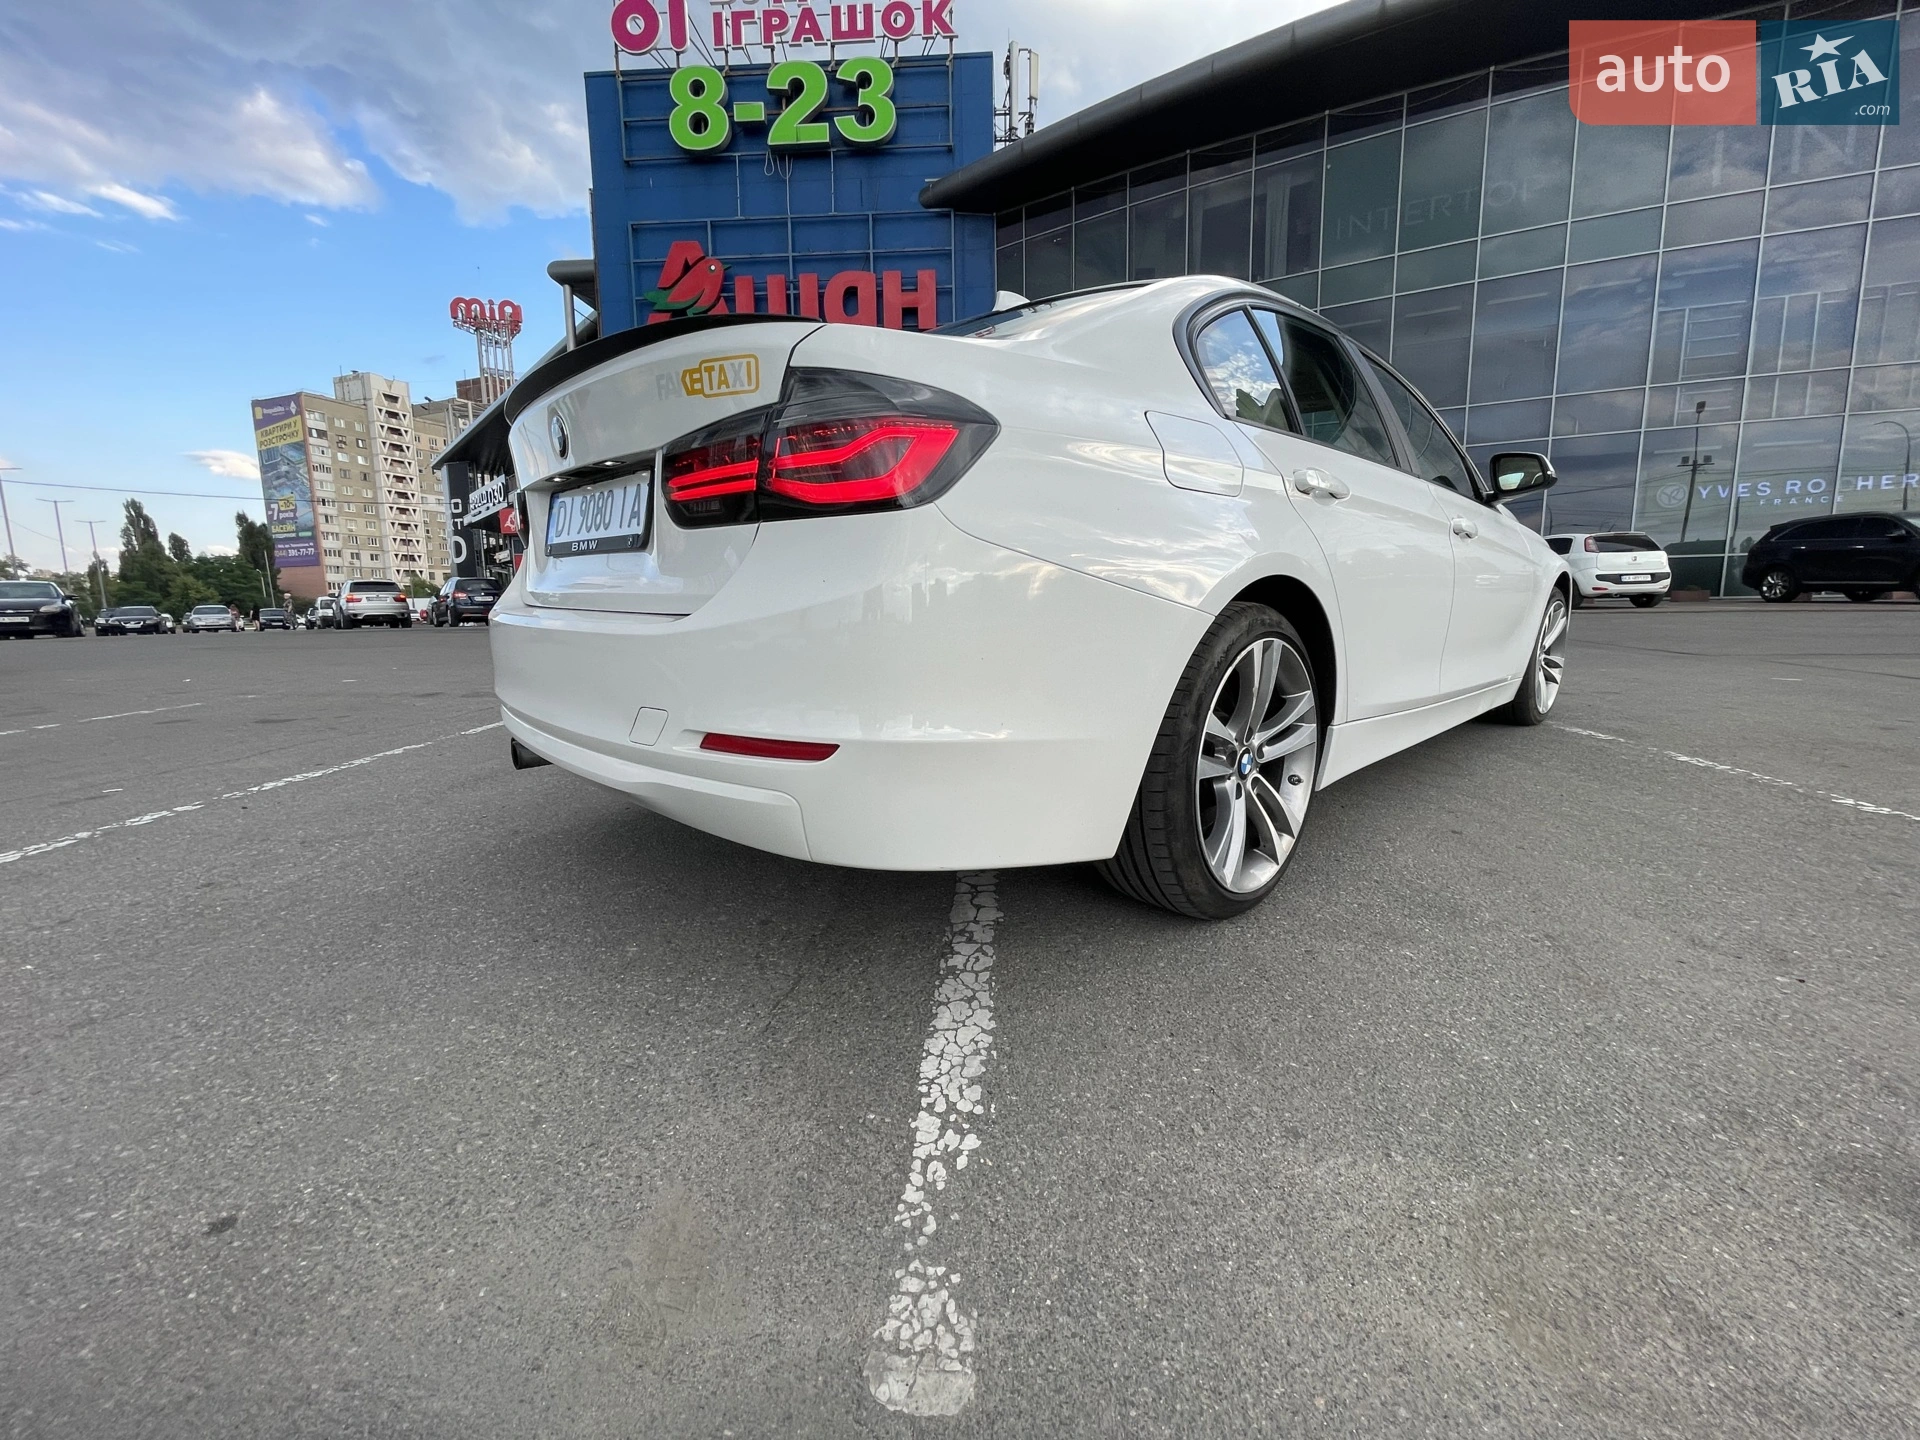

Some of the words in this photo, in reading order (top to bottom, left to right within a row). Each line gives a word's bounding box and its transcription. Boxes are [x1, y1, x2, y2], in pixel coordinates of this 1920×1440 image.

[712, 0, 958, 51] ІГРАШОК
[668, 57, 898, 151] 8-23
[1336, 175, 1550, 241] INTERTOP
[703, 360, 754, 392] TAXI
[259, 429, 300, 448] РОЗСТРОЧКУ
[1698, 482, 1772, 500] YVES
[1759, 494, 1844, 506] FRANCE
[577, 489, 614, 535] 9080
[571, 540, 598, 551] BMW
